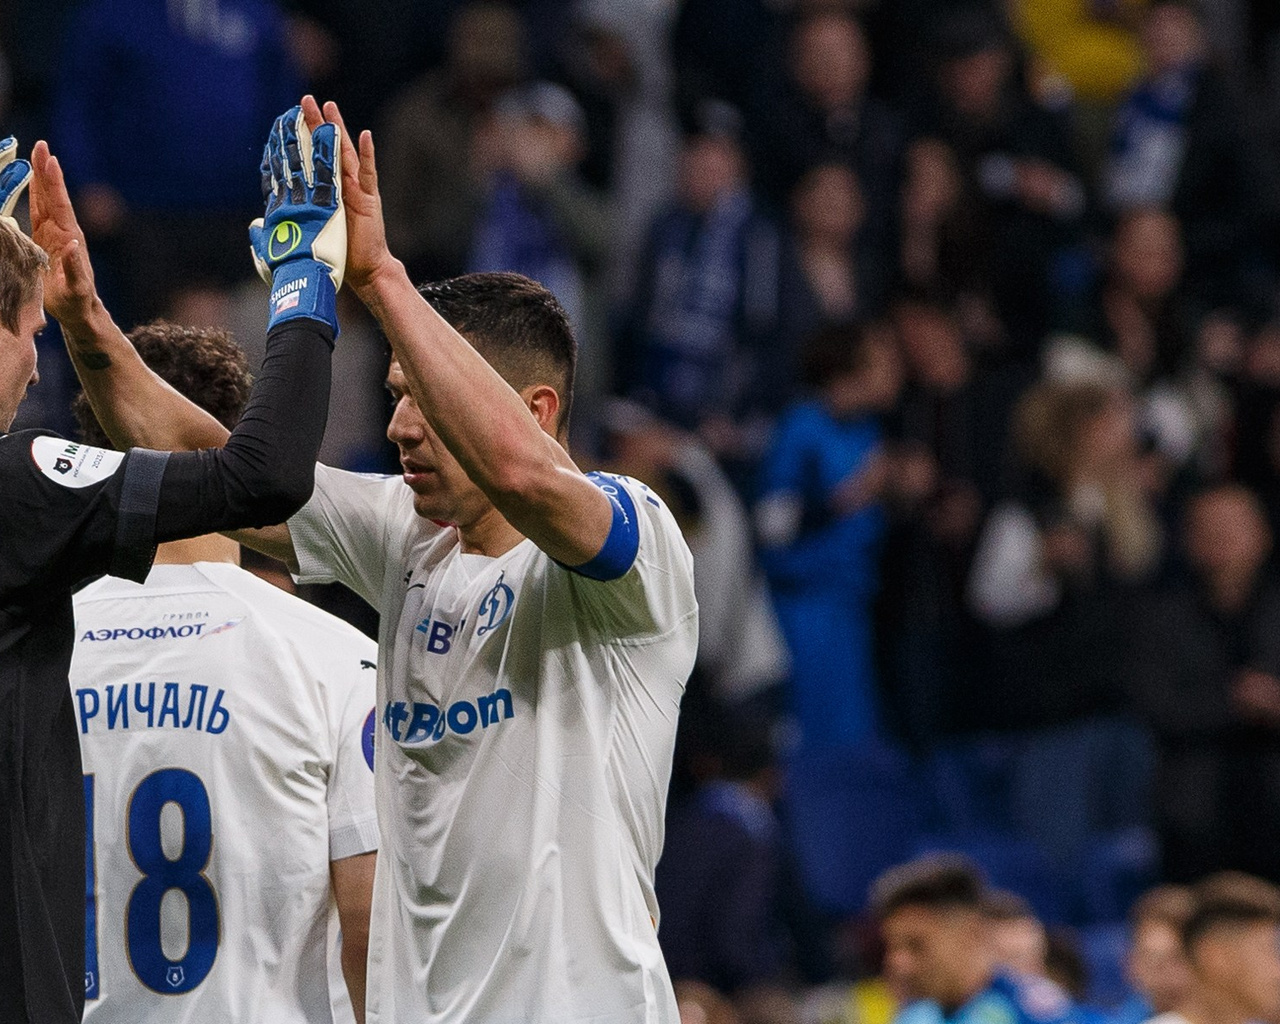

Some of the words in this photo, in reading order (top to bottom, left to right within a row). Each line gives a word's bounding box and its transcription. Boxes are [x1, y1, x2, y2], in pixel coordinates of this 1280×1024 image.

[271, 277, 307, 304] SHUNIN
[162, 611, 210, 621] ГРУППА
[80, 623, 207, 642] АЭРОФЛОТ
